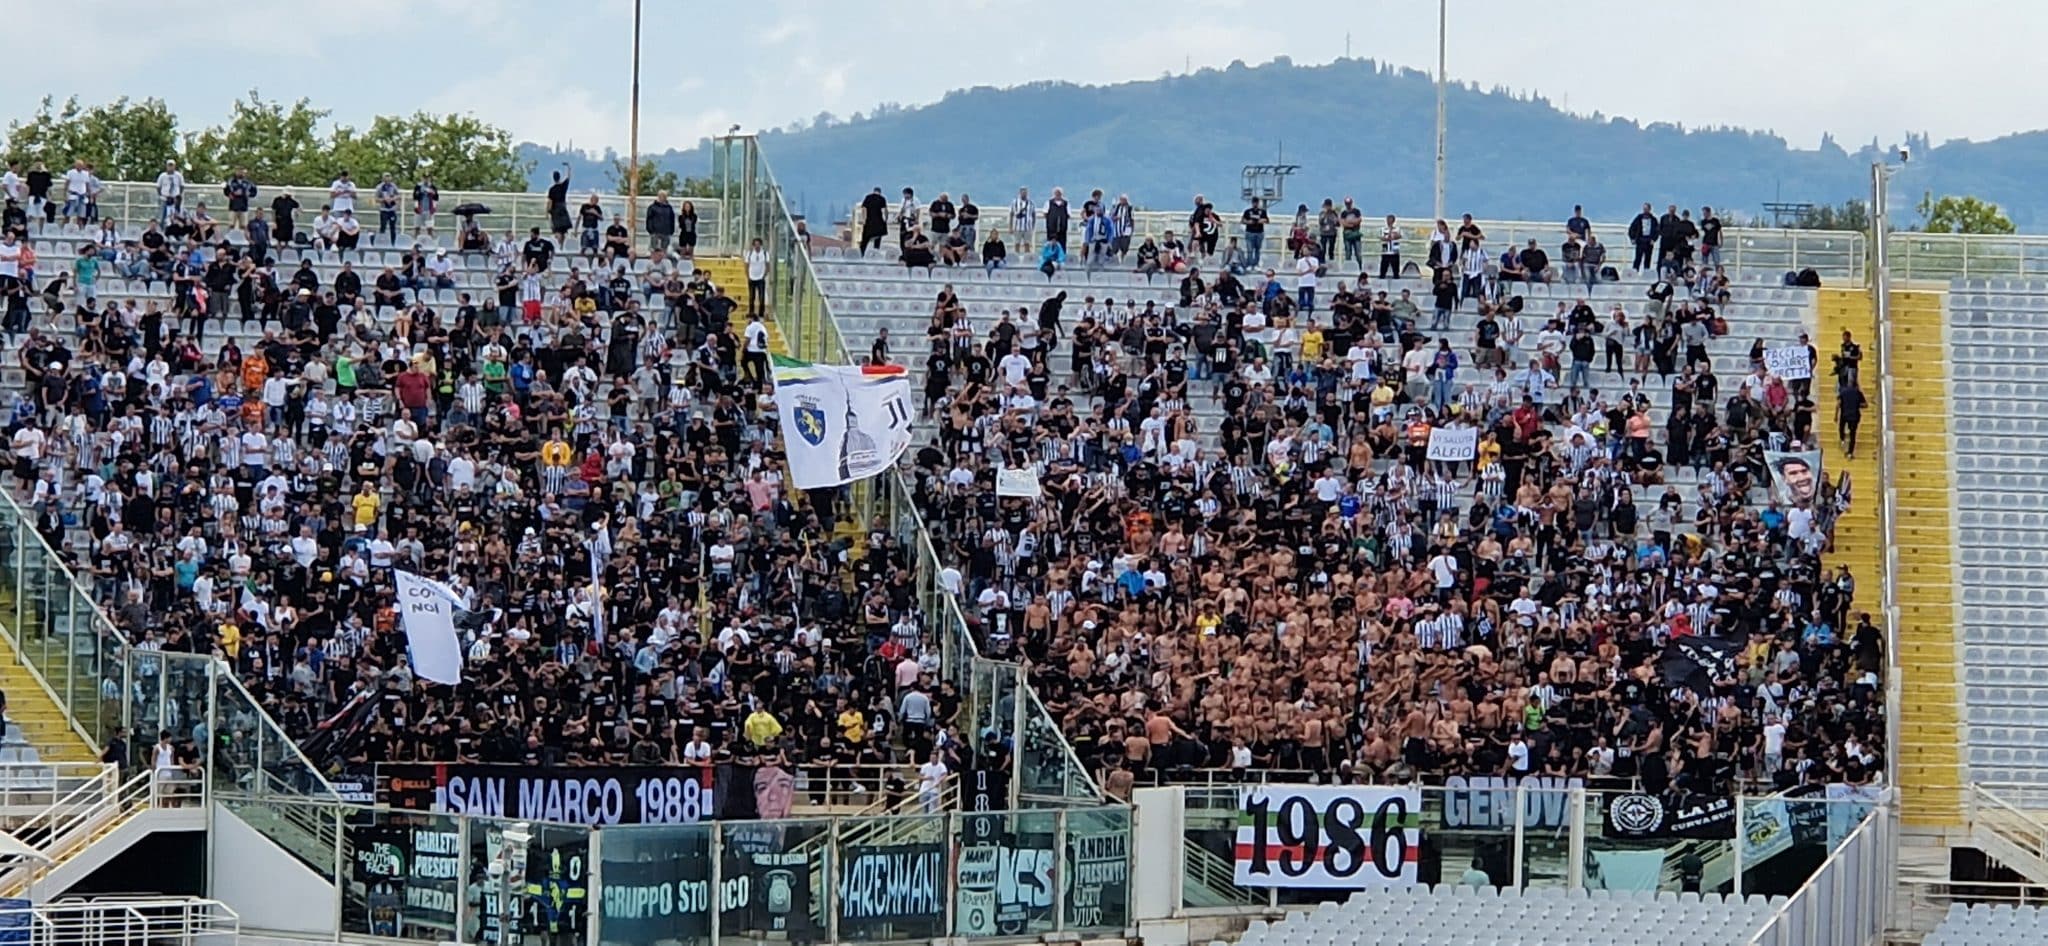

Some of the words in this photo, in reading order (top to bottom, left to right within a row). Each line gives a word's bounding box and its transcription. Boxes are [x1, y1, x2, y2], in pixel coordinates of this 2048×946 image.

[1432, 446, 1472, 457] ALFIO
[408, 587, 436, 599] CO
[412, 602, 440, 614] NOI
[448, 776, 505, 818] SAN
[519, 777, 623, 826] MARCO
[636, 778, 701, 826] 1988
[1246, 794, 1408, 878] 1986
[372, 842, 391, 855] THE
[1079, 835, 1126, 859] ANDRIA
[358, 850, 392, 866] SOUTH
[964, 849, 993, 863] MANU
[366, 862, 390, 875] FACE
[1079, 861, 1126, 885] PRESENTE
[838, 852, 941, 917] MAREMMANI
[960, 870, 979, 884] CON
[407, 887, 456, 913] MEDA
[604, 882, 673, 919] GRUPPO
[678, 875, 749, 913] STOICO
